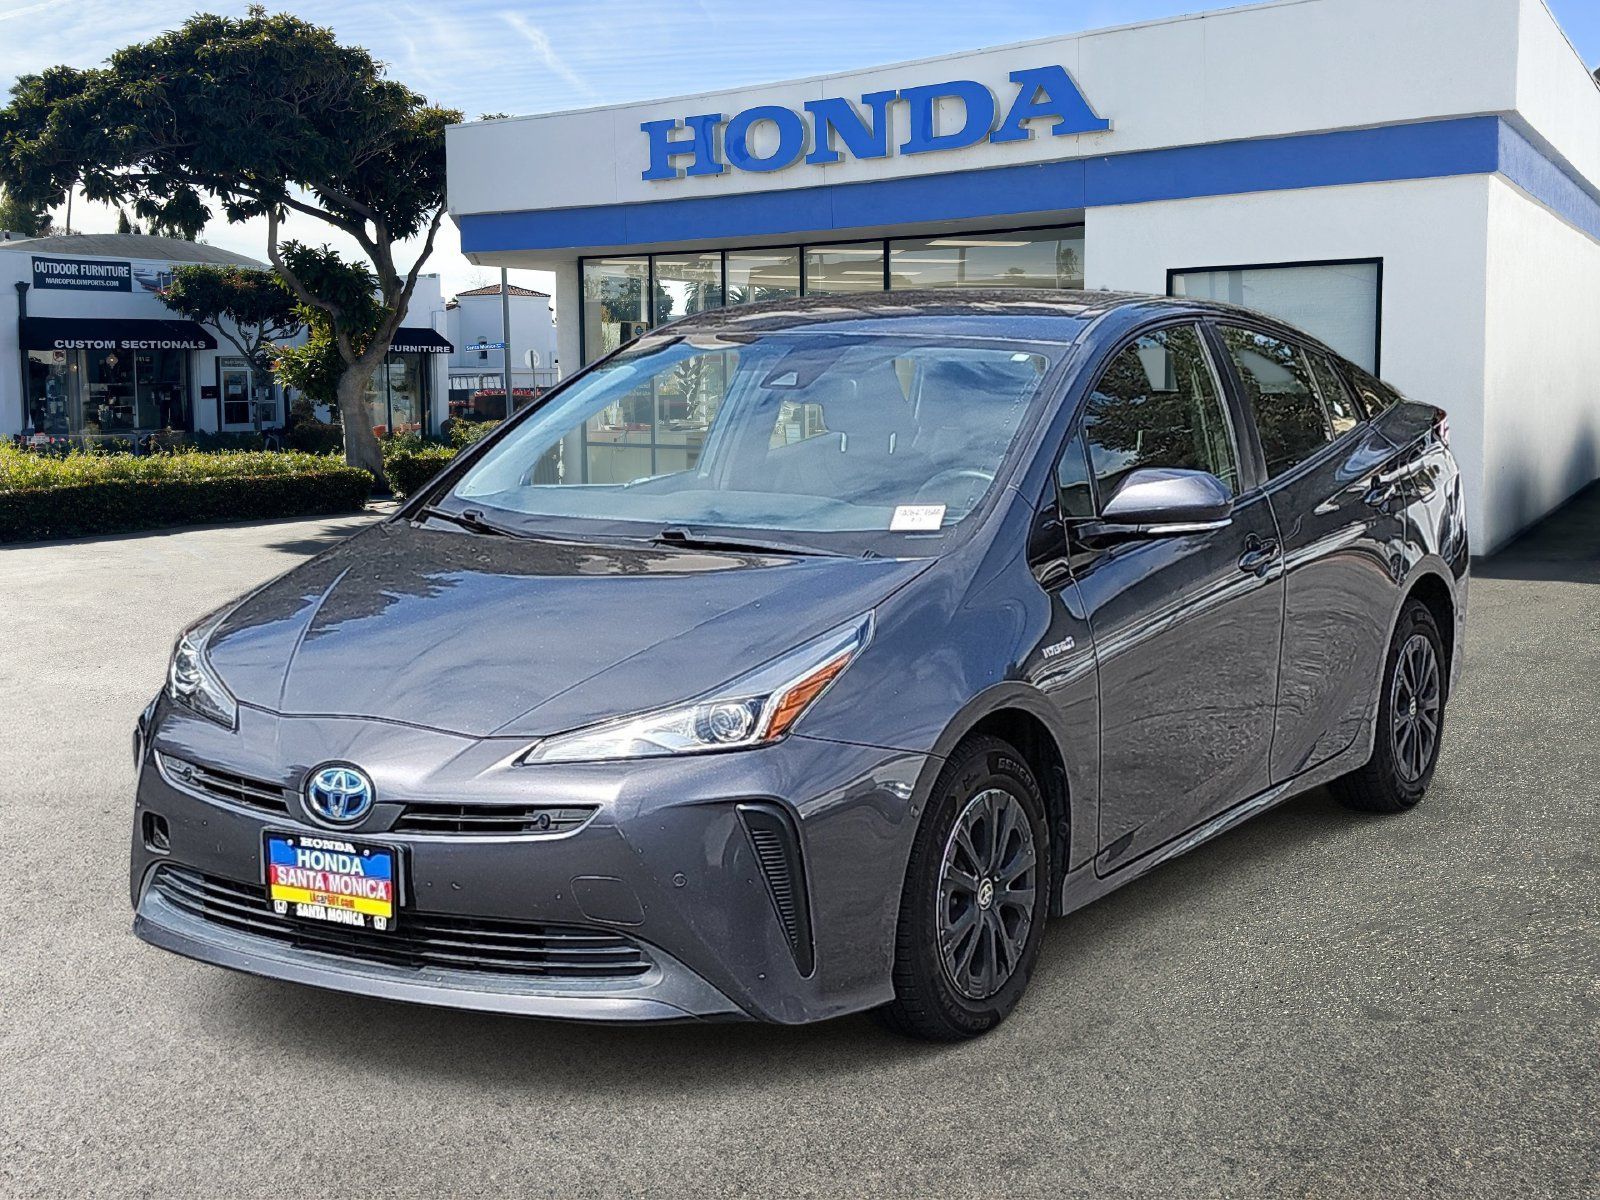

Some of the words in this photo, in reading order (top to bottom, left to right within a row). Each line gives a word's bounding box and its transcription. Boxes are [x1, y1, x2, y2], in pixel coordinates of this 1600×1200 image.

[640, 64, 1112, 181] HONDA
[34, 261, 78, 275] OUTDOOR
[80, 264, 130, 277] FURNITURE
[45, 277, 119, 287] MARCOPOLOIMPORTS.COM
[54, 340, 116, 349] CUSTOM
[121, 340, 206, 349] SECTIONALS
[388, 344, 451, 353] FURNITURE
[300, 836, 357, 854] HONDA
[296, 848, 364, 876] HONDA
[277, 867, 325, 890] SANTA
[328, 874, 387, 900] MONICA
[296, 903, 326, 920] SANTA
[327, 908, 365, 926] MONICA
